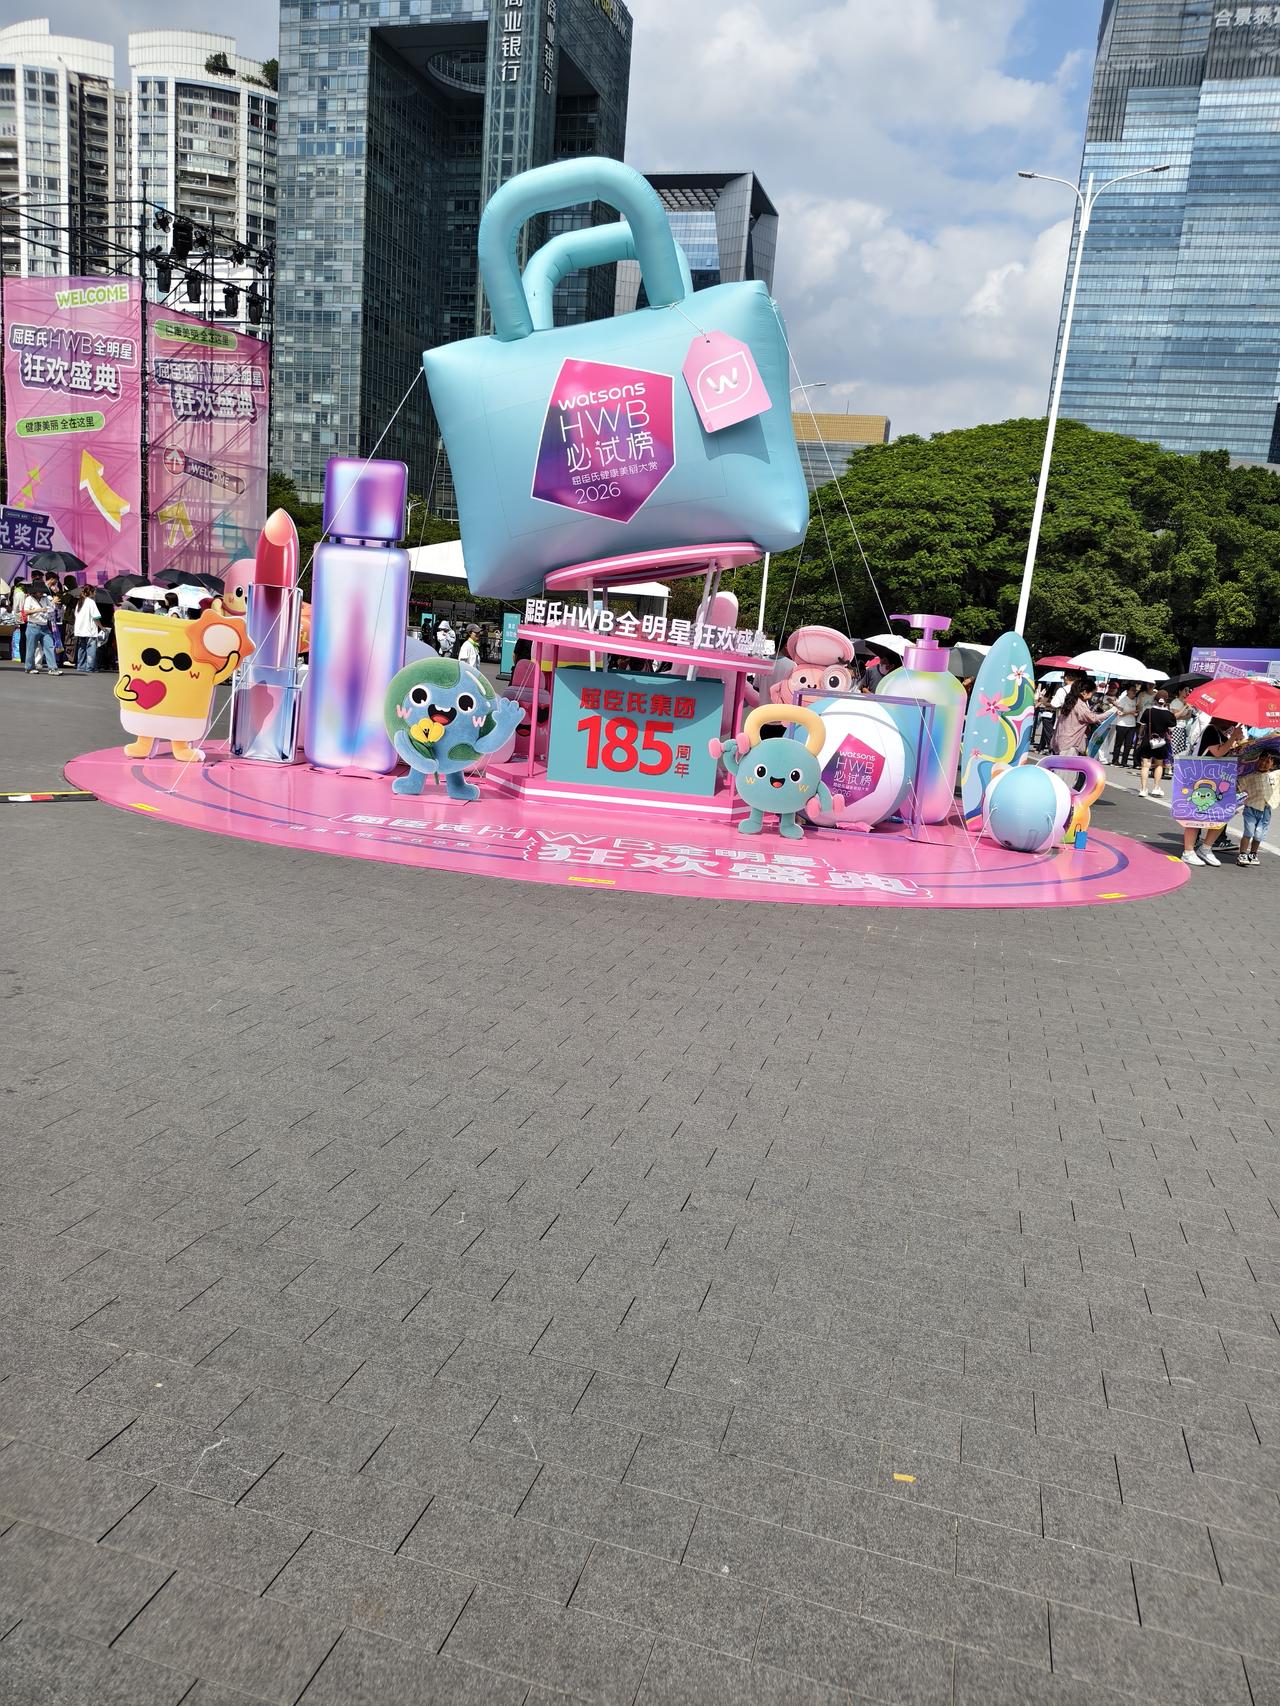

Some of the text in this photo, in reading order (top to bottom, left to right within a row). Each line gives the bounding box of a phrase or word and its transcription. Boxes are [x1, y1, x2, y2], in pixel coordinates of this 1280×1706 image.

[57, 285, 128, 308] WELCOME
[12, 328, 133, 361] 屈臣氏HWB全明星
[24, 352, 118, 394] 狂欢盛典
[557, 382, 647, 412] watsons
[25, 416, 95, 434] 健康美丽 全在这里
[559, 399, 651, 442] HWB
[567, 431, 656, 473] 必试榜
[571, 460, 659, 486] 屈臣氏健康美丽大赏
[575, 481, 622, 505] 2026
[580, 687, 697, 720] 屈臣氏集团
[577, 715, 674, 776] 185
[673, 744, 692, 777] 周年
[839, 750, 876, 761] watsons
[833, 770, 872, 787] 必试榜
[836, 758, 875, 775] HWB
[536, 844, 920, 896] 狂欢盛典
